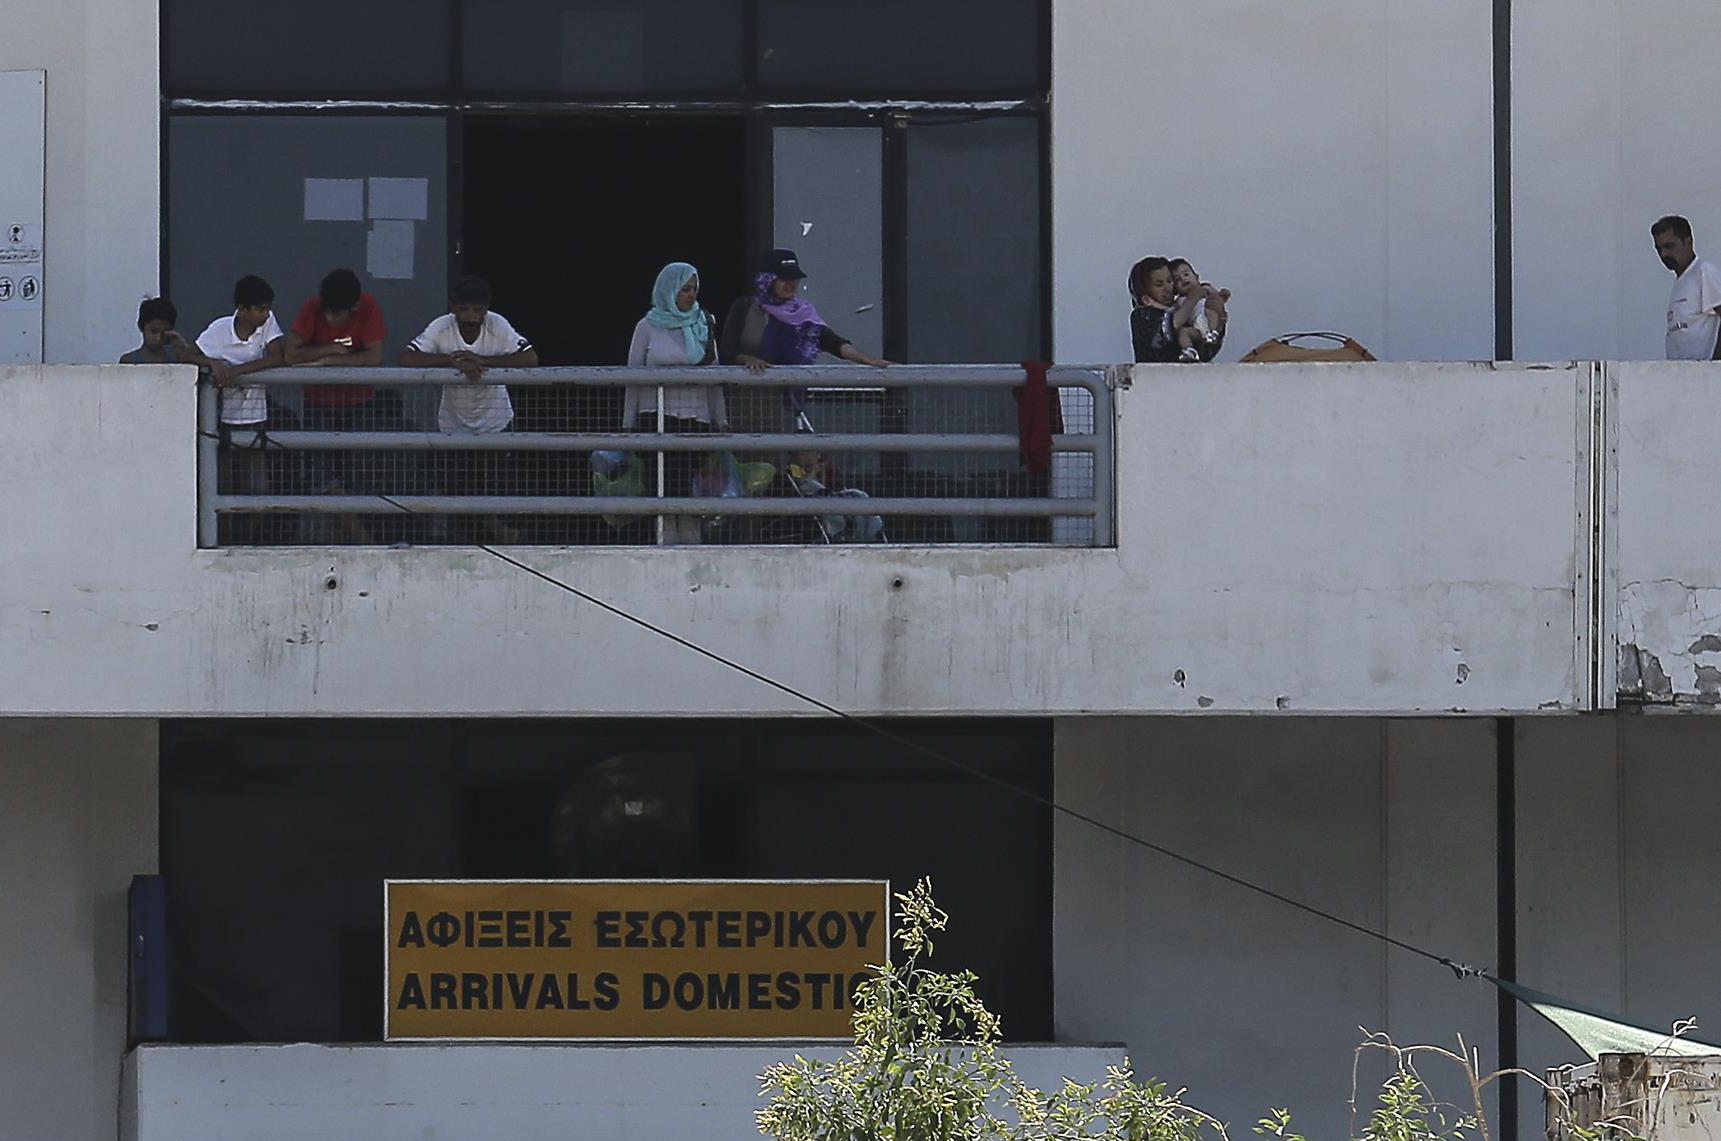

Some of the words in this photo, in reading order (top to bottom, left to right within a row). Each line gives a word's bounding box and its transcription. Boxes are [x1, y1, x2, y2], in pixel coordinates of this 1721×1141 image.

[397, 911, 572, 948] ΑΦΙΞΕΙΣ
[595, 911, 877, 948] ΕΣΩΤΕΡΙΚΟΥ
[397, 972, 620, 1010] ARRIVALS
